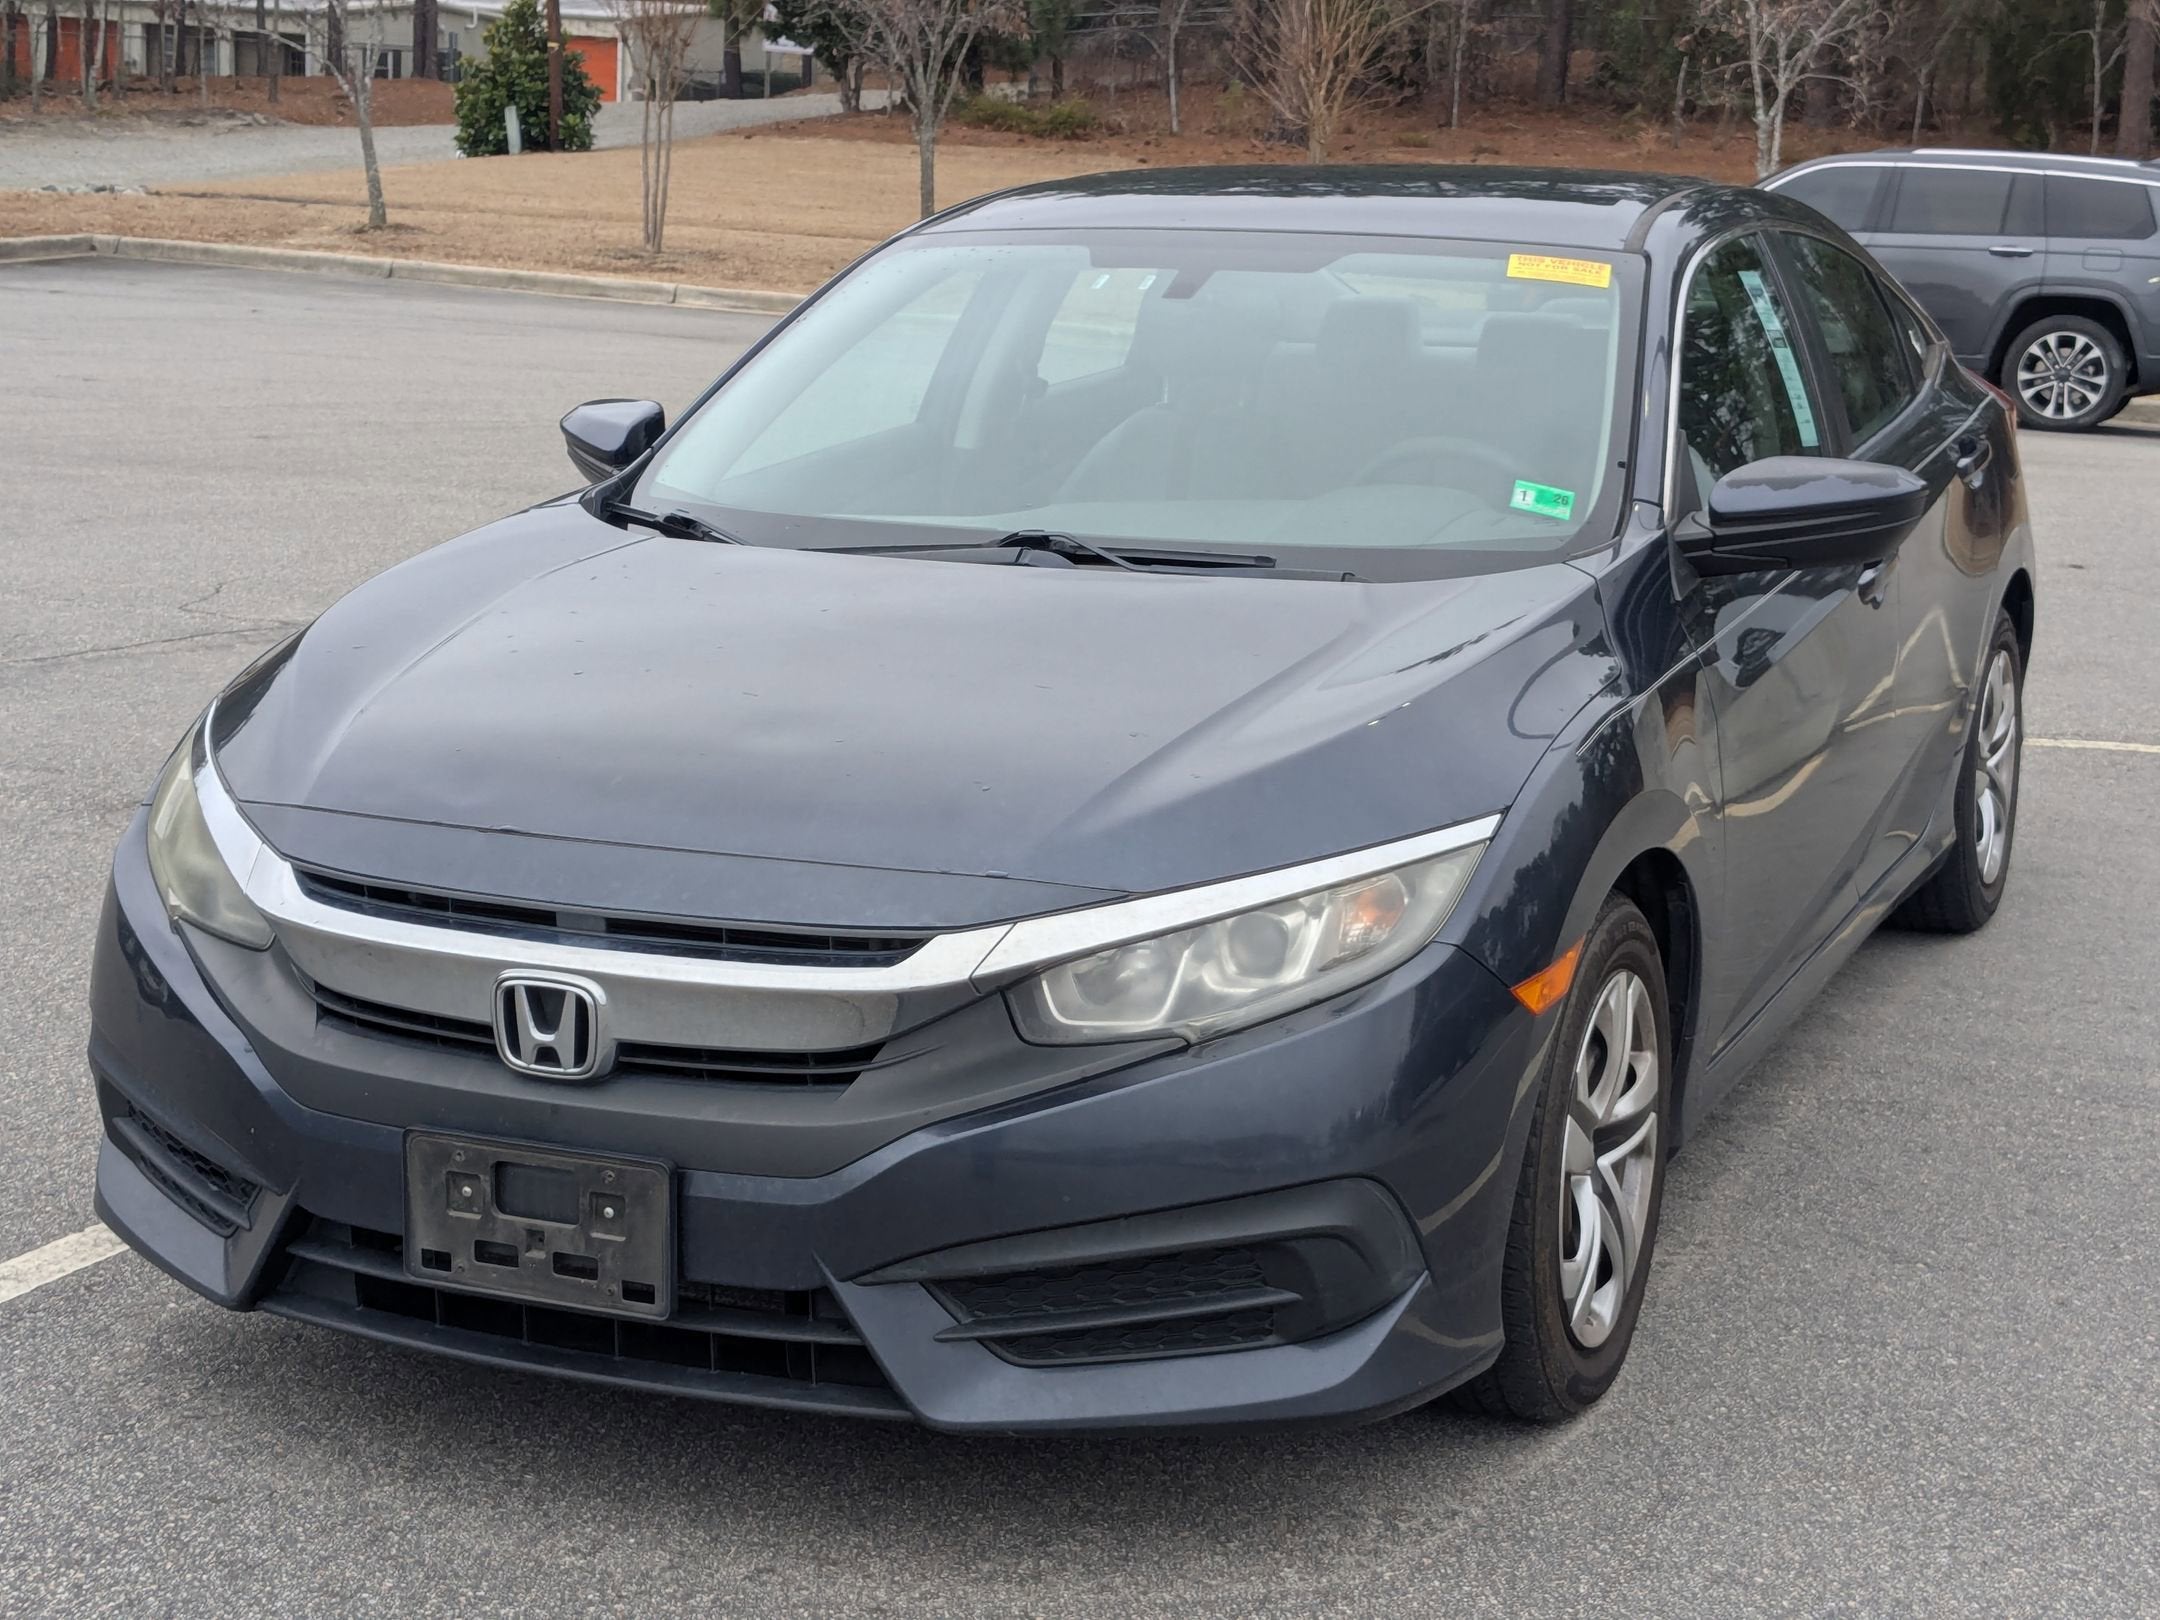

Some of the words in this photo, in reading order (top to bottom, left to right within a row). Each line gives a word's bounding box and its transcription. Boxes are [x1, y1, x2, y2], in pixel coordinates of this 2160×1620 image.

[1517, 255, 1545, 264] THIS
[1550, 258, 1606, 271] VEHICLE
[1573, 267, 1601, 275] SALE
